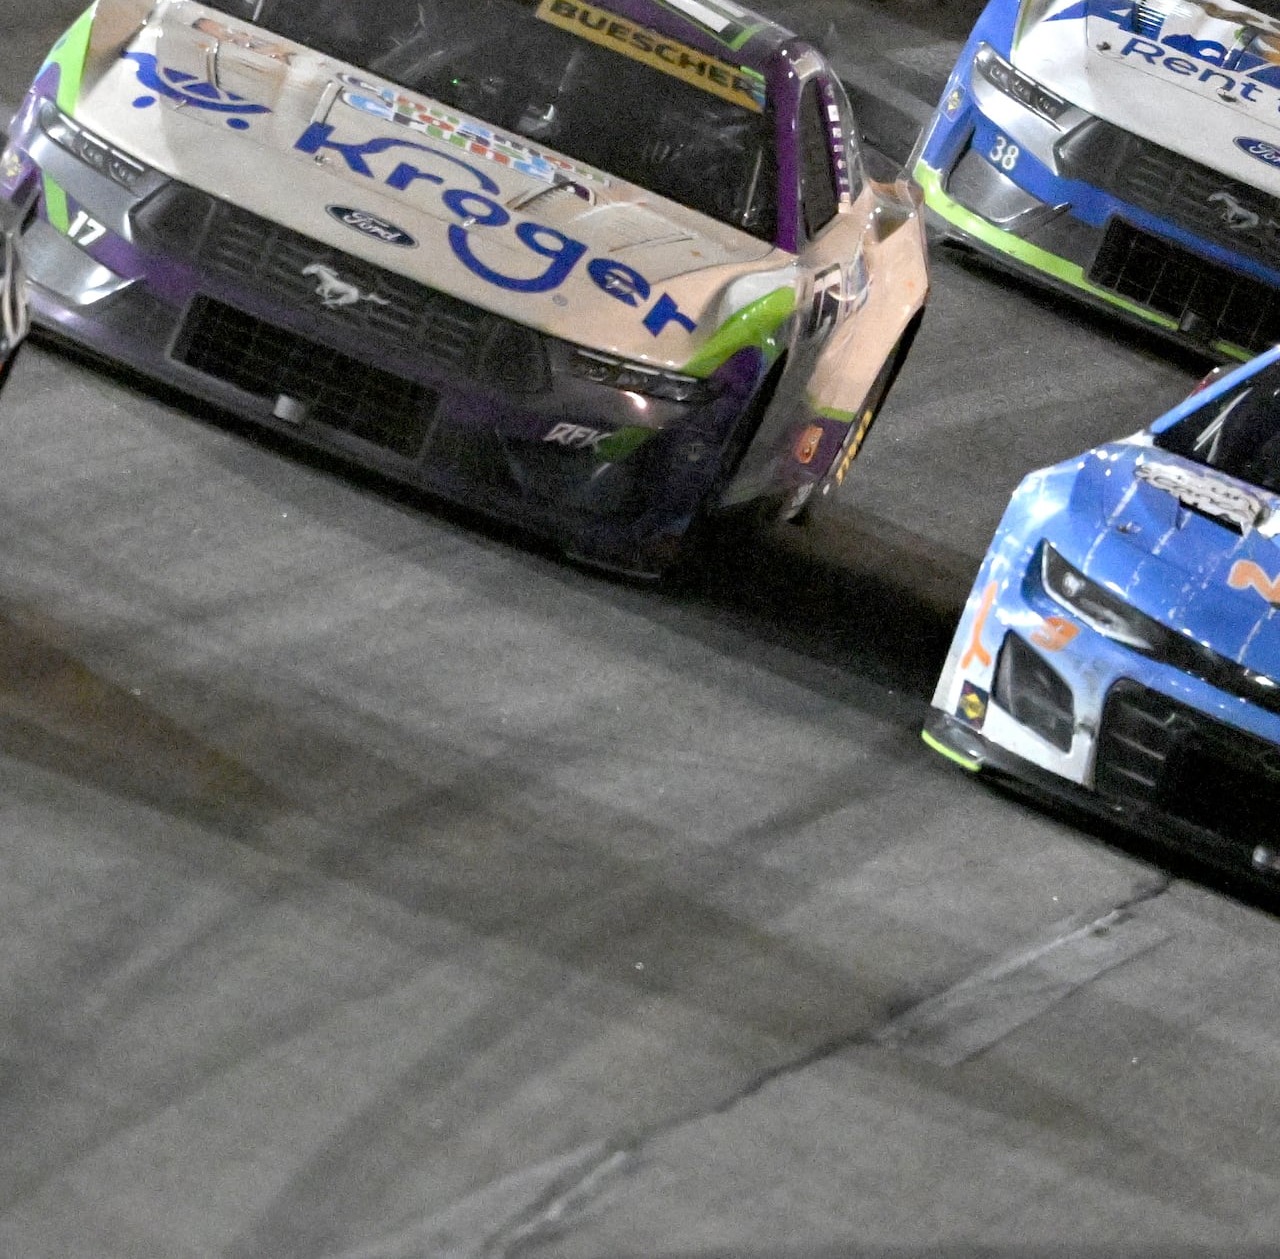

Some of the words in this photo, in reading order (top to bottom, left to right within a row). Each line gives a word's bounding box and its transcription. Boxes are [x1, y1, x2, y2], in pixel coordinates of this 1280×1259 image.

[1120, 37, 1268, 103] Rent
[988, 135, 1019, 171] 38
[68, 210, 107, 247] 17
[294, 121, 698, 338] Kroger
